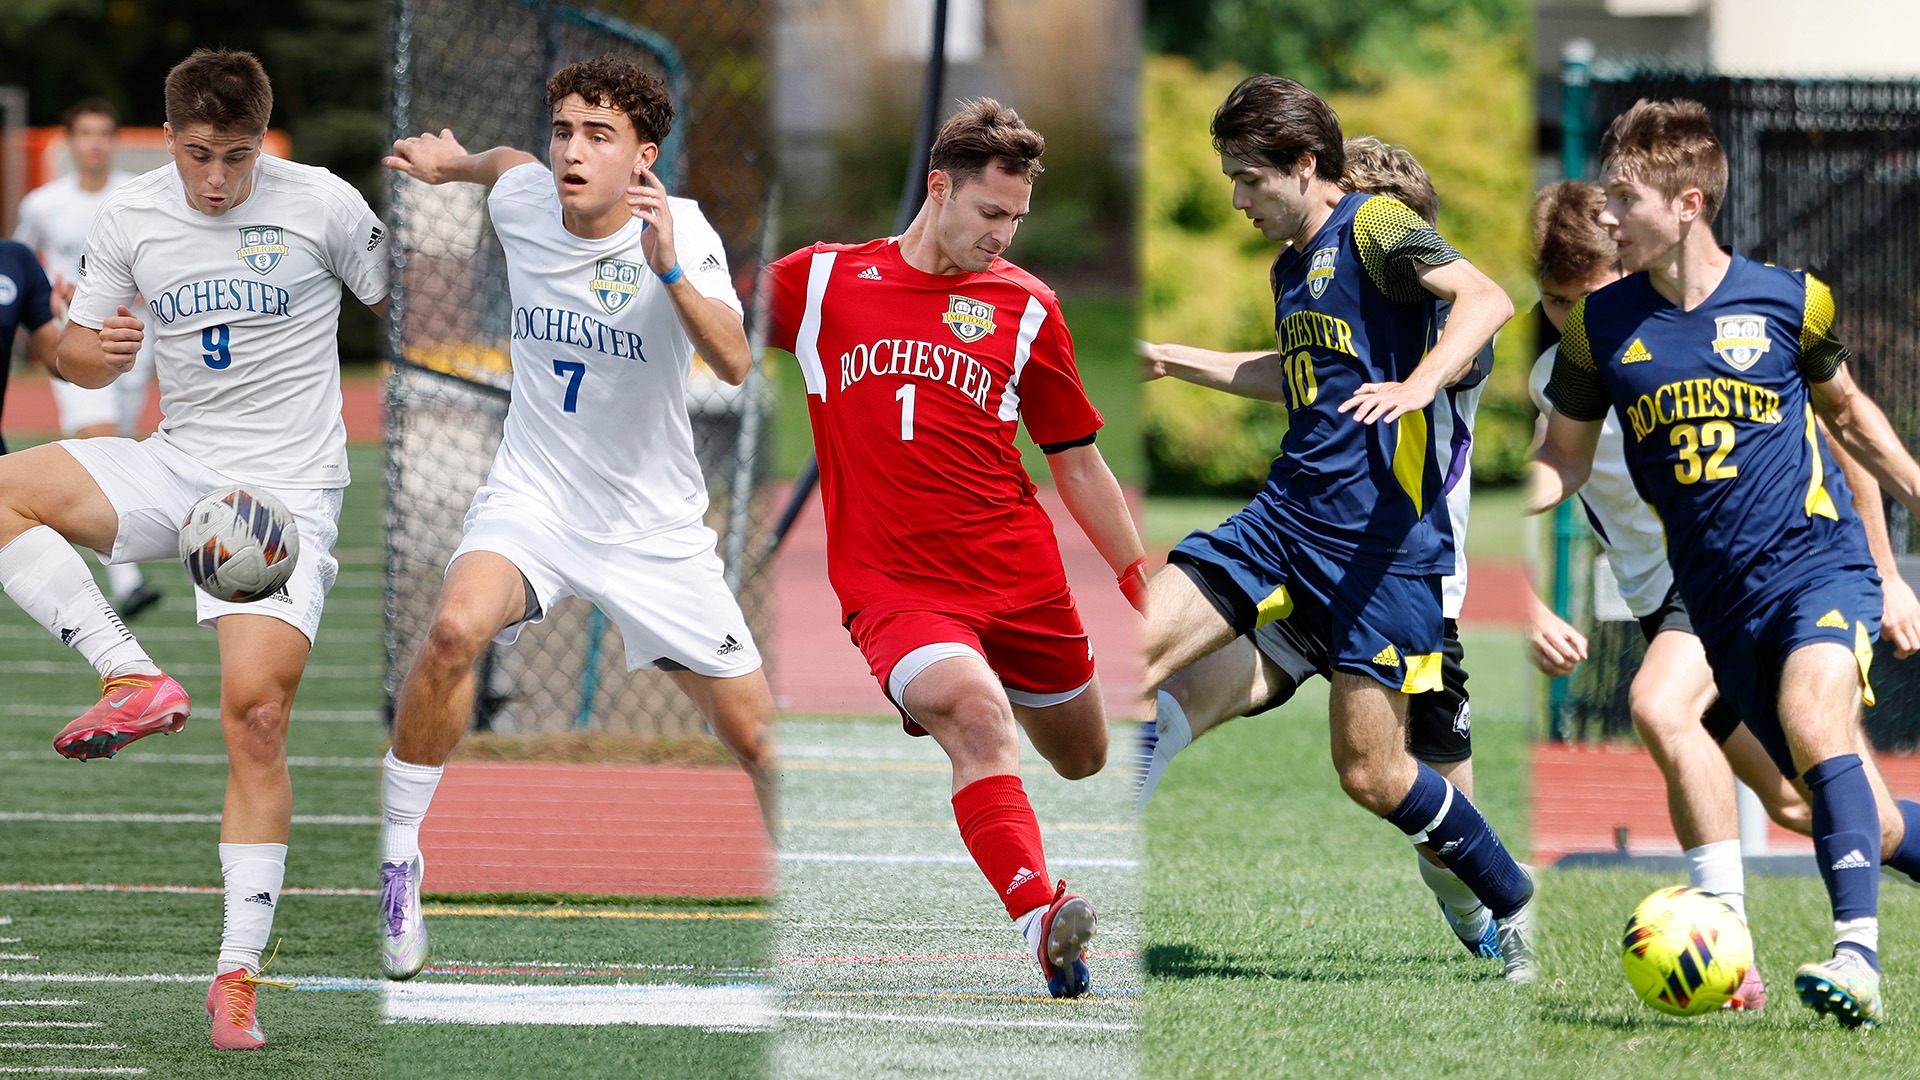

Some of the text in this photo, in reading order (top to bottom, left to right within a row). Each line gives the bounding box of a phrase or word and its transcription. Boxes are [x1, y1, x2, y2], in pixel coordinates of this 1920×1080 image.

[242, 244, 283, 256] MELIORA
[595, 279, 637, 295] MELIORA
[950, 314, 990, 329] MELIORA
[1275, 310, 1359, 358] CHESTER
[201, 323, 232, 370] 9
[1621, 352, 1653, 365] adidas
[840, 338, 993, 412] ROCHESTER
[1283, 350, 1319, 410] 10
[552, 359, 586, 414] 7
[895, 383, 917, 441] 1
[1626, 377, 1784, 443] ROCHESTER
[1669, 420, 1739, 485] 32
[269, 593, 294, 605] didas
[1816, 621, 1849, 631] adidas
[716, 643, 744, 656] adidas
[1372, 656, 1400, 668] adidas
[1832, 861, 1872, 871] adidas
[1006, 871, 1041, 895] adidas
